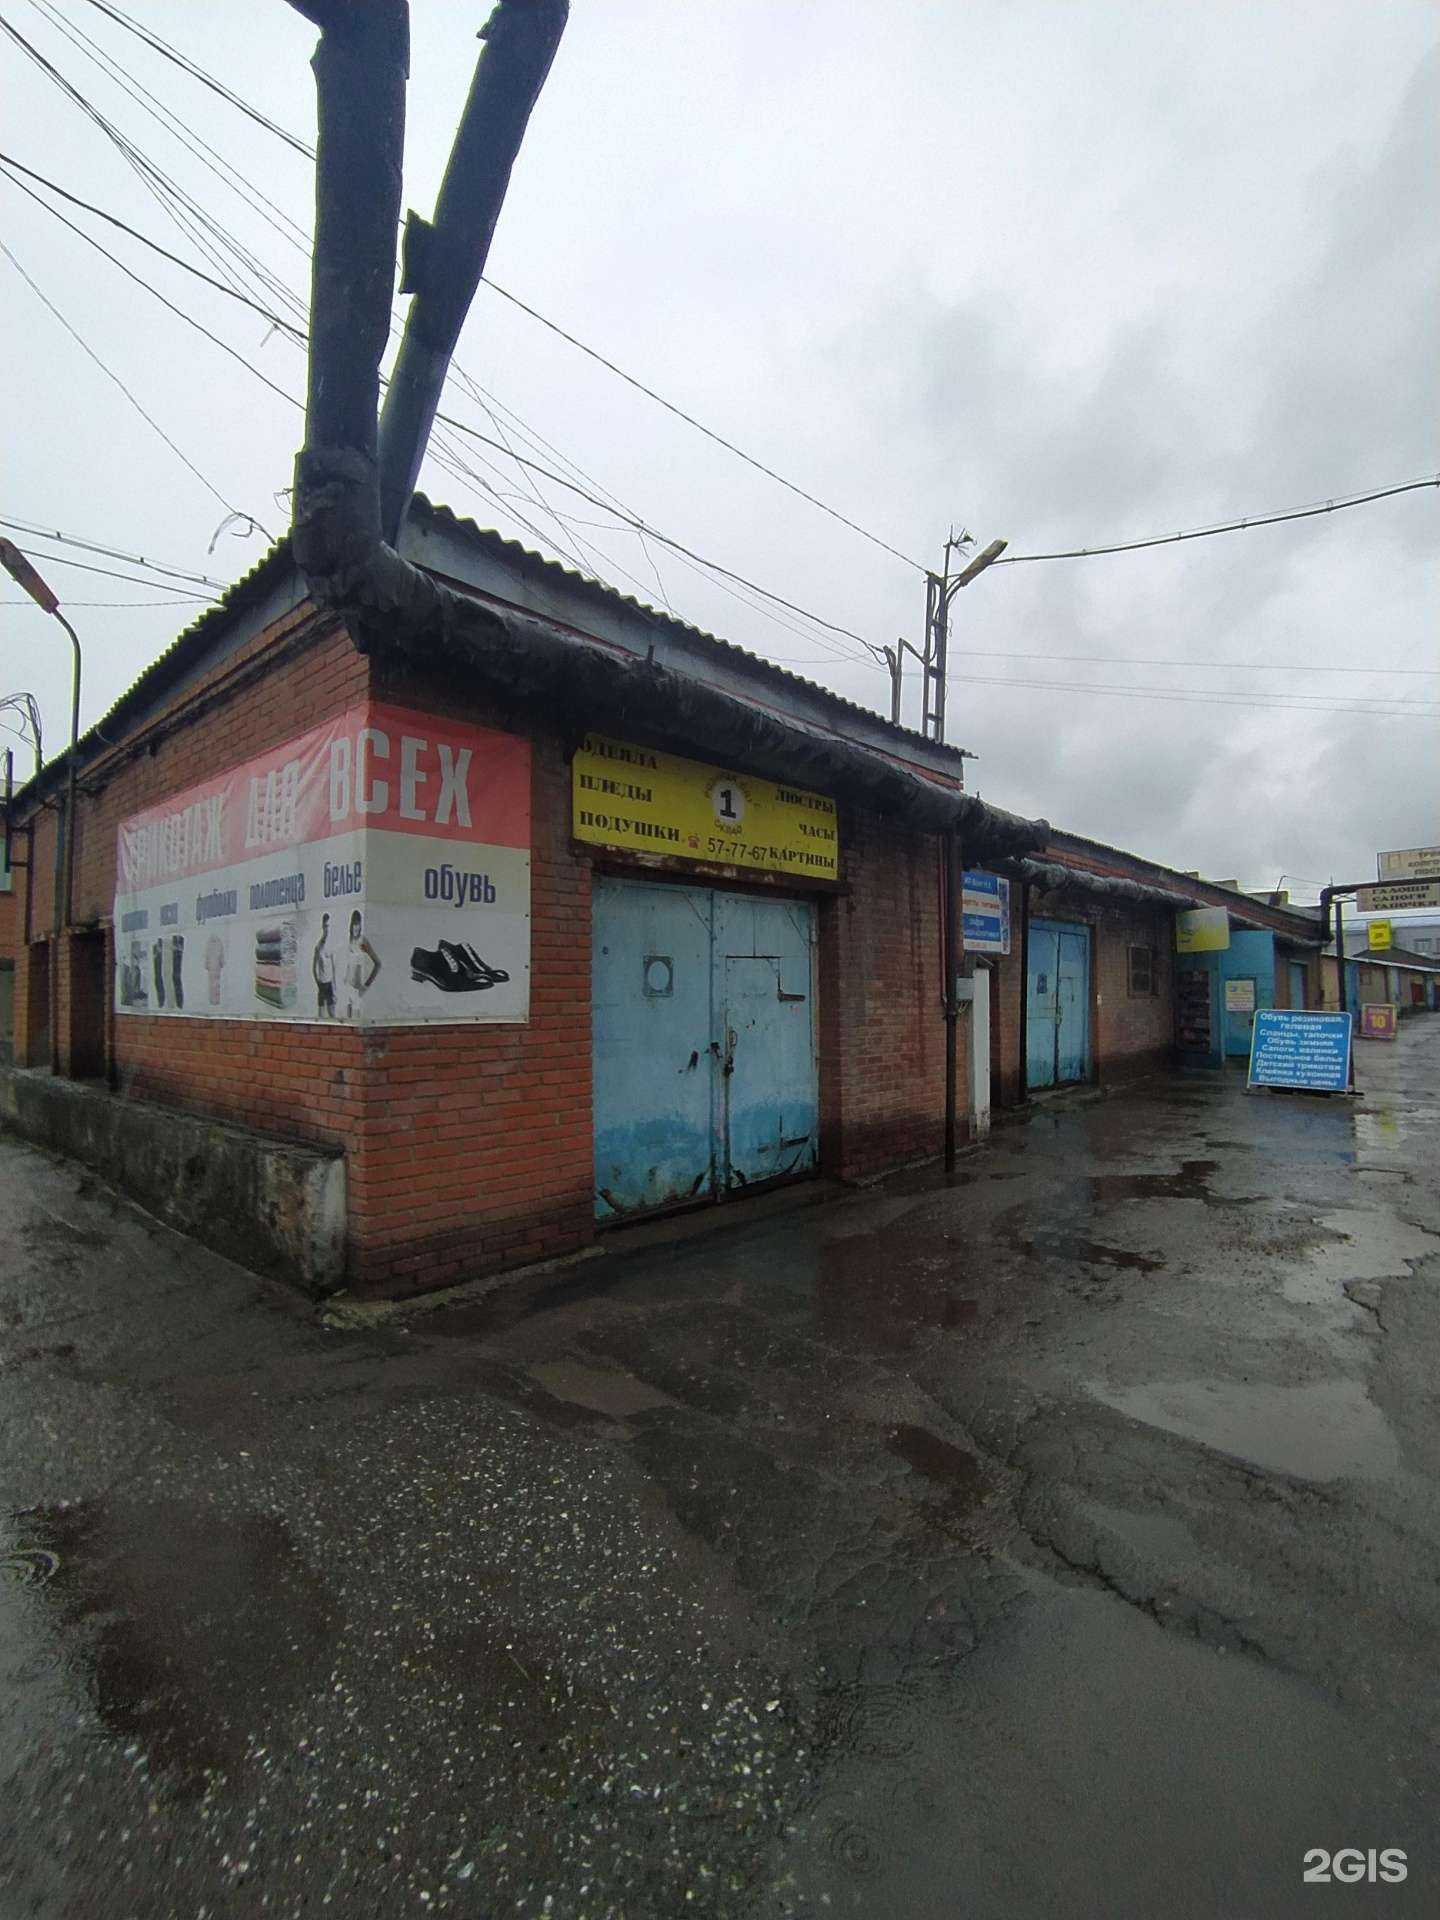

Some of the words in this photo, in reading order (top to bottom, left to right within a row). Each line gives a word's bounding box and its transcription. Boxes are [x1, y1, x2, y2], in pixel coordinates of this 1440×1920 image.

[245, 759, 300, 848] ДЛЯ
[329, 728, 473, 828] ВСЕХ
[579, 774, 652, 803] ПЛЕДЫ
[775, 788, 834, 814] ЛЮСТРЫ
[719, 789, 737, 819] 1
[579, 810, 681, 842] ПОДУШКИ
[798, 823, 835, 842] ЧАСЫ
[707, 837, 768, 862] 57-77-67
[769, 846, 835, 869] КАРТИНЫ
[323, 861, 362, 899] белье
[424, 864, 496, 908] обувь
[1260, 1013, 1290, 1023] Обувь
